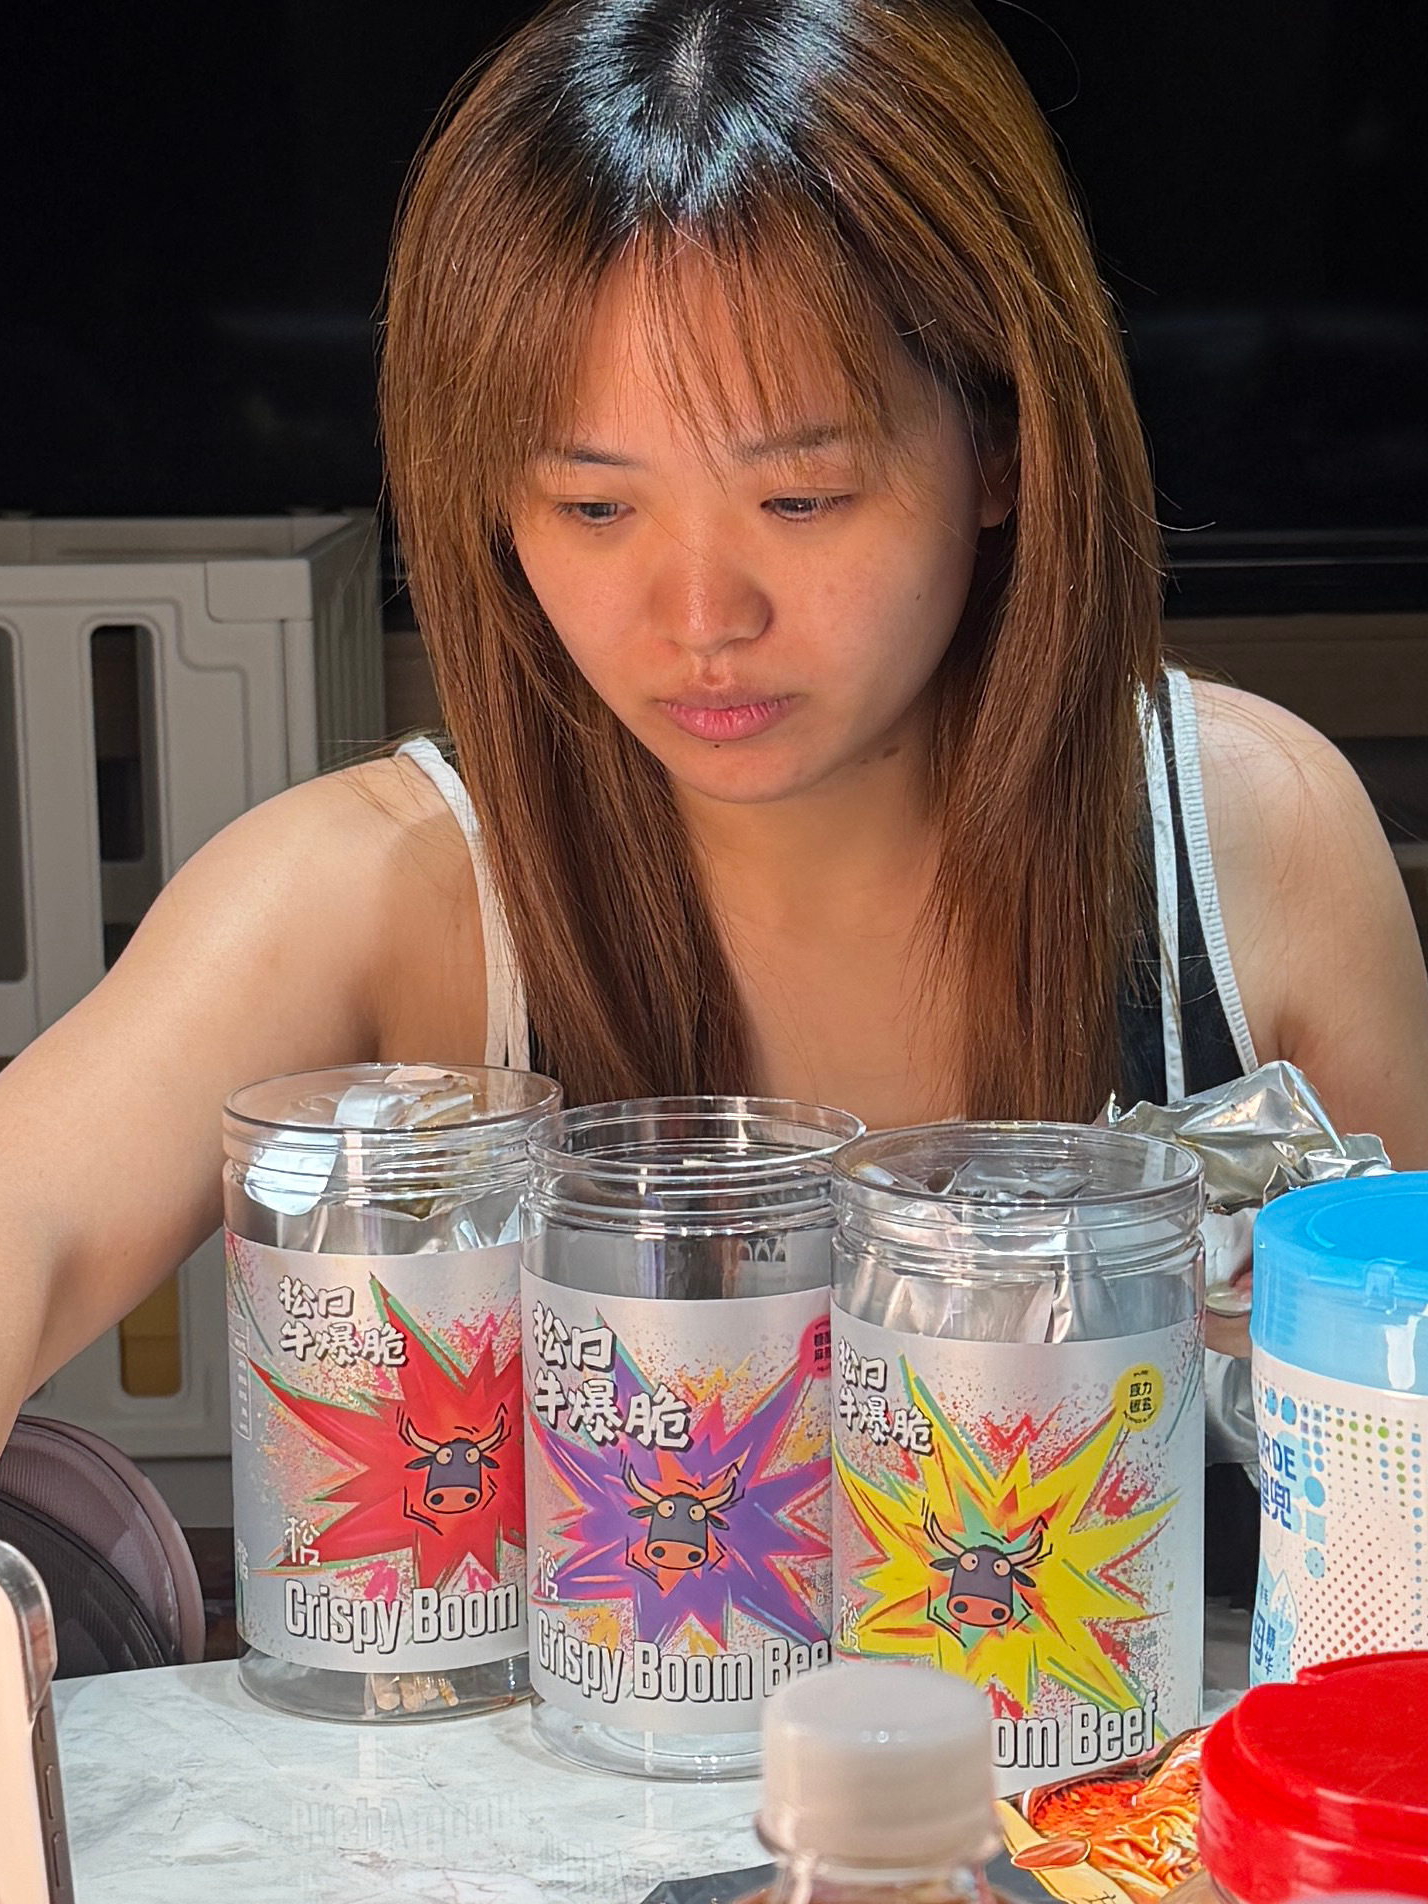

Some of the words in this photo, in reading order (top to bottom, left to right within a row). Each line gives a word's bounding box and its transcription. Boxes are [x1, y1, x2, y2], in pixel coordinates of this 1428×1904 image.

[278, 1318, 407, 1369] 牛爆脆
[531, 1373, 694, 1450] 牛爆脆
[837, 1388, 934, 1456] 牛爆脆
[283, 1578, 405, 1655] Crispy
[411, 1582, 519, 1644] Boom
[535, 1608, 623, 1704] Crispy
[632, 1640, 754, 1703] Boom
[763, 1636, 831, 1696] Bee
[1070, 1694, 1158, 1766] Beef
